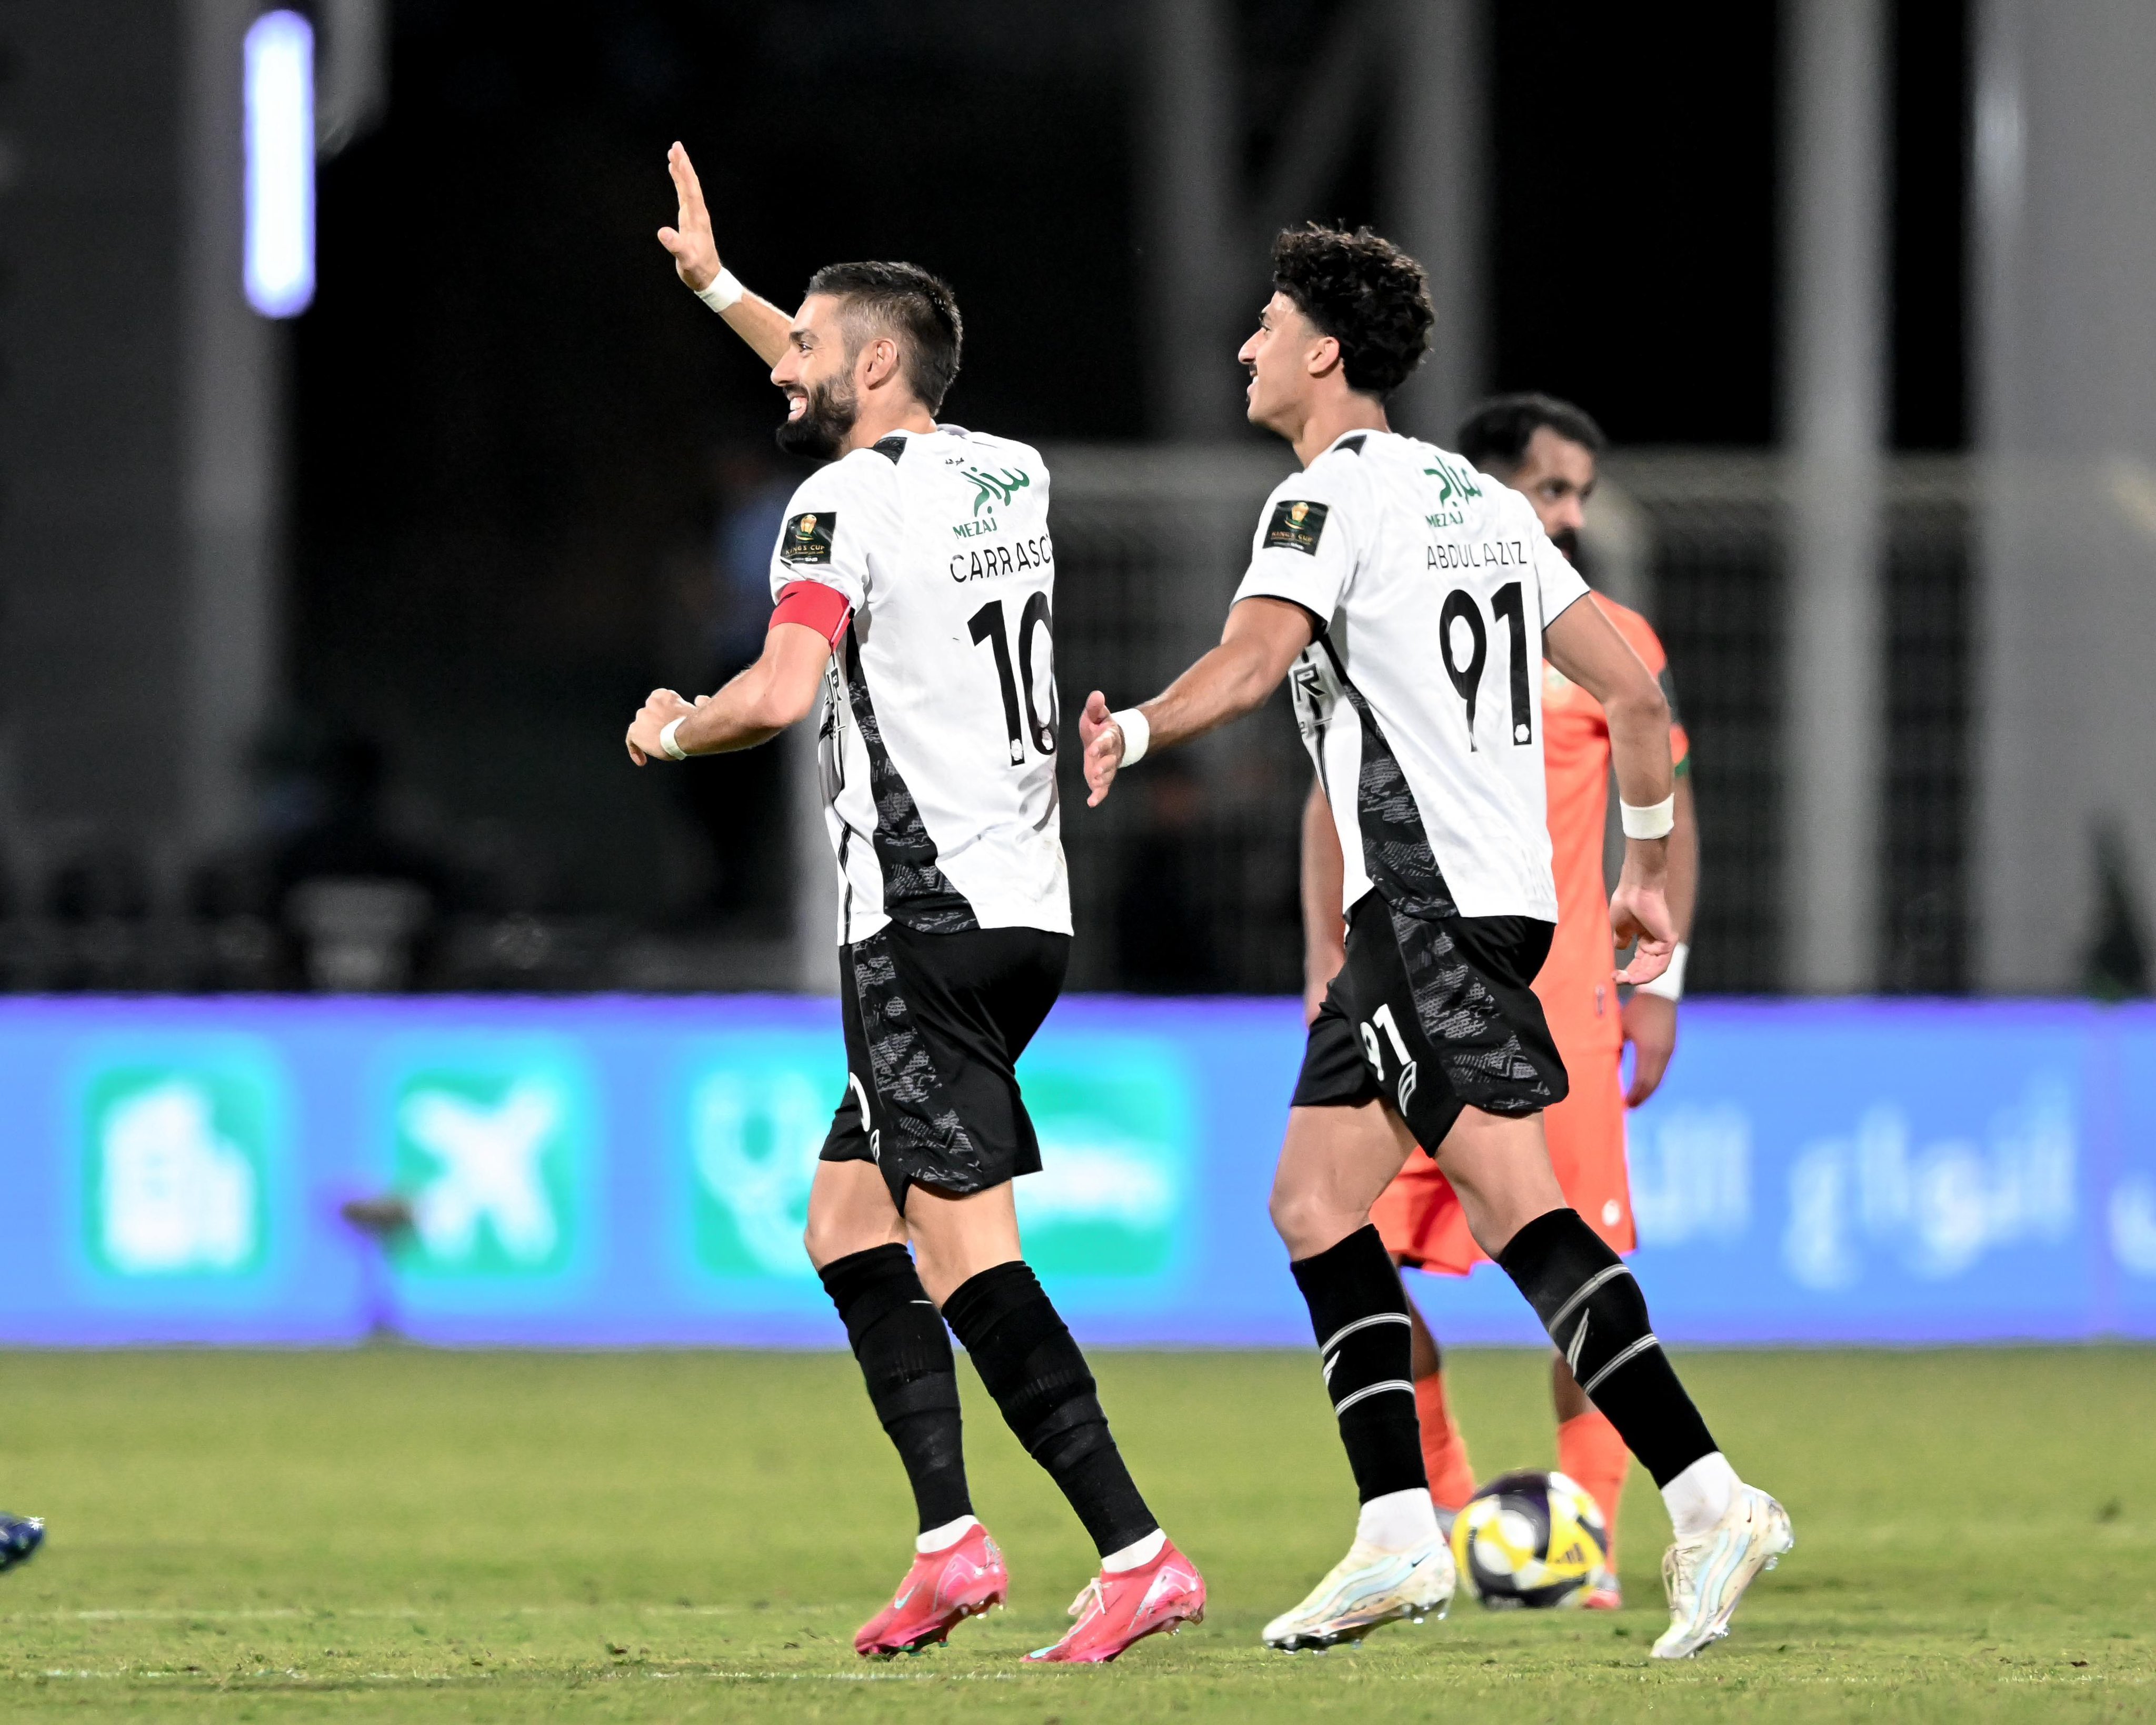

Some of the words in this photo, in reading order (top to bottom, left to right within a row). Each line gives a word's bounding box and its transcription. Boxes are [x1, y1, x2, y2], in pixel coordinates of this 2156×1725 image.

[952, 517, 997, 539] MEZAJ
[1425, 511, 1463, 527] MEZAJ
[950, 533, 1052, 583] CARRASC
[967, 591, 1057, 766] 10
[1439, 581, 1532, 752] 91
[1360, 1004, 1412, 1081] 91
